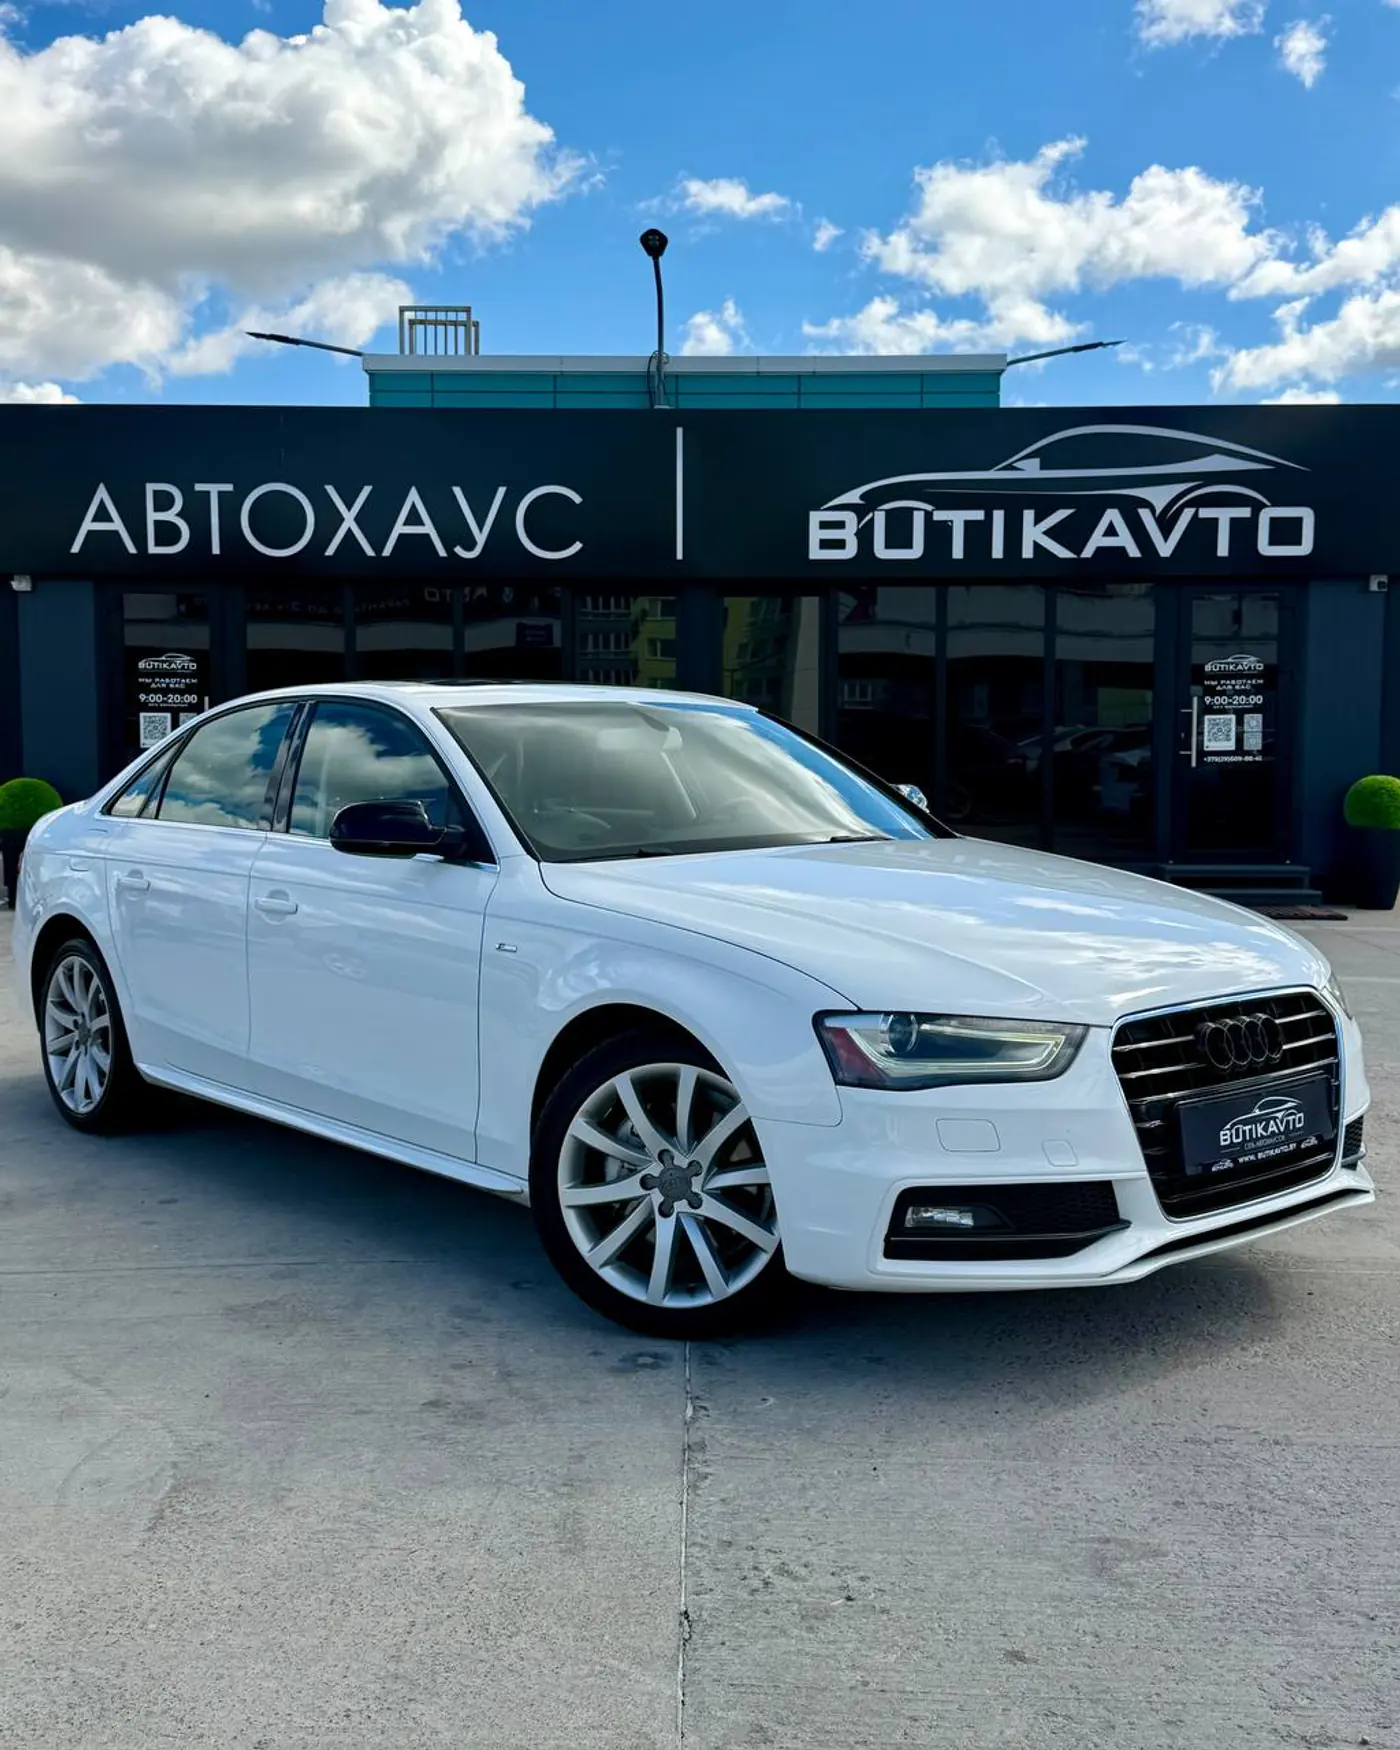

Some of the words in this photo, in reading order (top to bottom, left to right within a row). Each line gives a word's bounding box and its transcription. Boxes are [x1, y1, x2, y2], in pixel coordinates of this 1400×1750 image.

[70, 482, 584, 560] АВТОХАУС
[808, 504, 1316, 561] BUTIKAVTO
[138, 662, 197, 670] BUTIKAVTO
[139, 693, 197, 703] 9:00-20:00
[1204, 695, 1263, 704] 9:00-20:00
[1219, 1113, 1305, 1146] BUTIKAVTO
